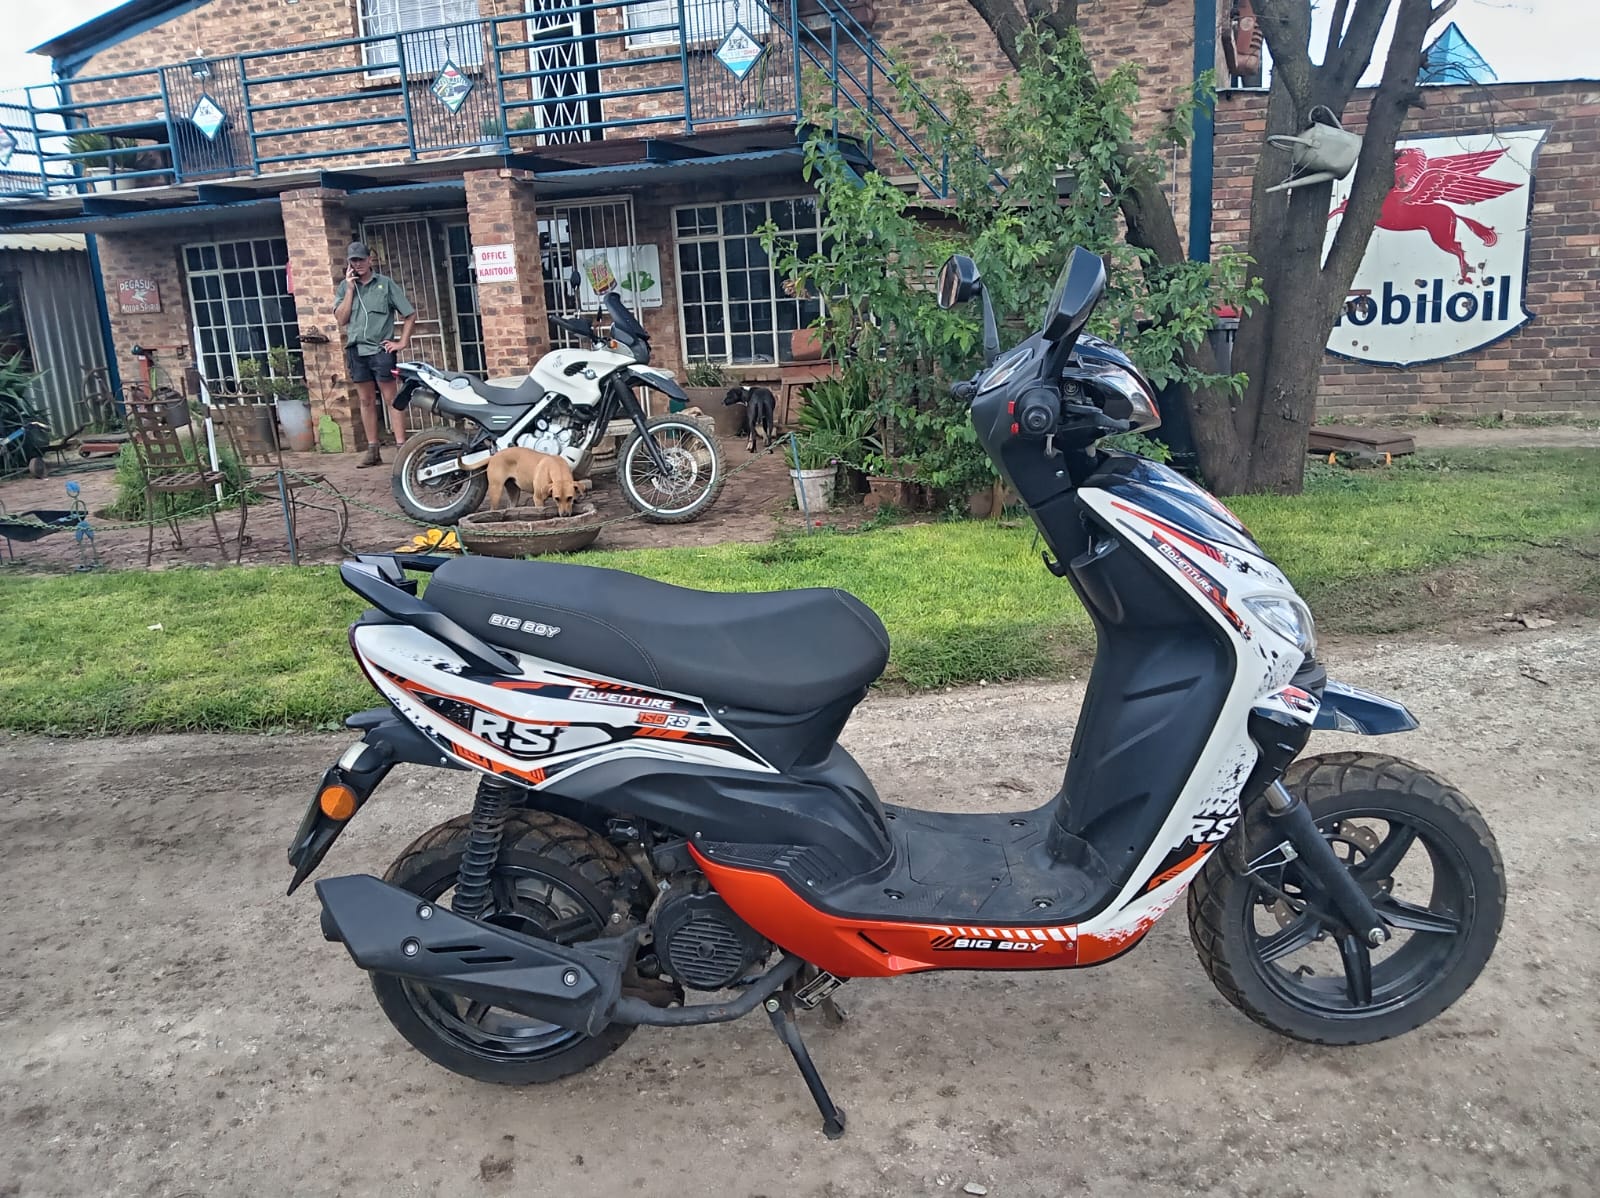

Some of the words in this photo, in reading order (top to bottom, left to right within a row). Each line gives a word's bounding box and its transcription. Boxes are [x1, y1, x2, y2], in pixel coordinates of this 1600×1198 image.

[481, 251, 507, 260] OFFICE
[479, 266, 513, 277] KANTOOR
[119, 279, 156, 293] PEGASUS
[1334, 275, 1511, 327] obiloil
[1157, 543, 1214, 593] ADVENTURE
[488, 613, 522, 630] BIG
[520, 620, 561, 638] BOY
[569, 688, 675, 710] ADVENTURE
[471, 708, 556, 753] RS
[1191, 817, 1240, 843] RS
[953, 938, 993, 949] BIG
[996, 940, 1044, 952] BOY
